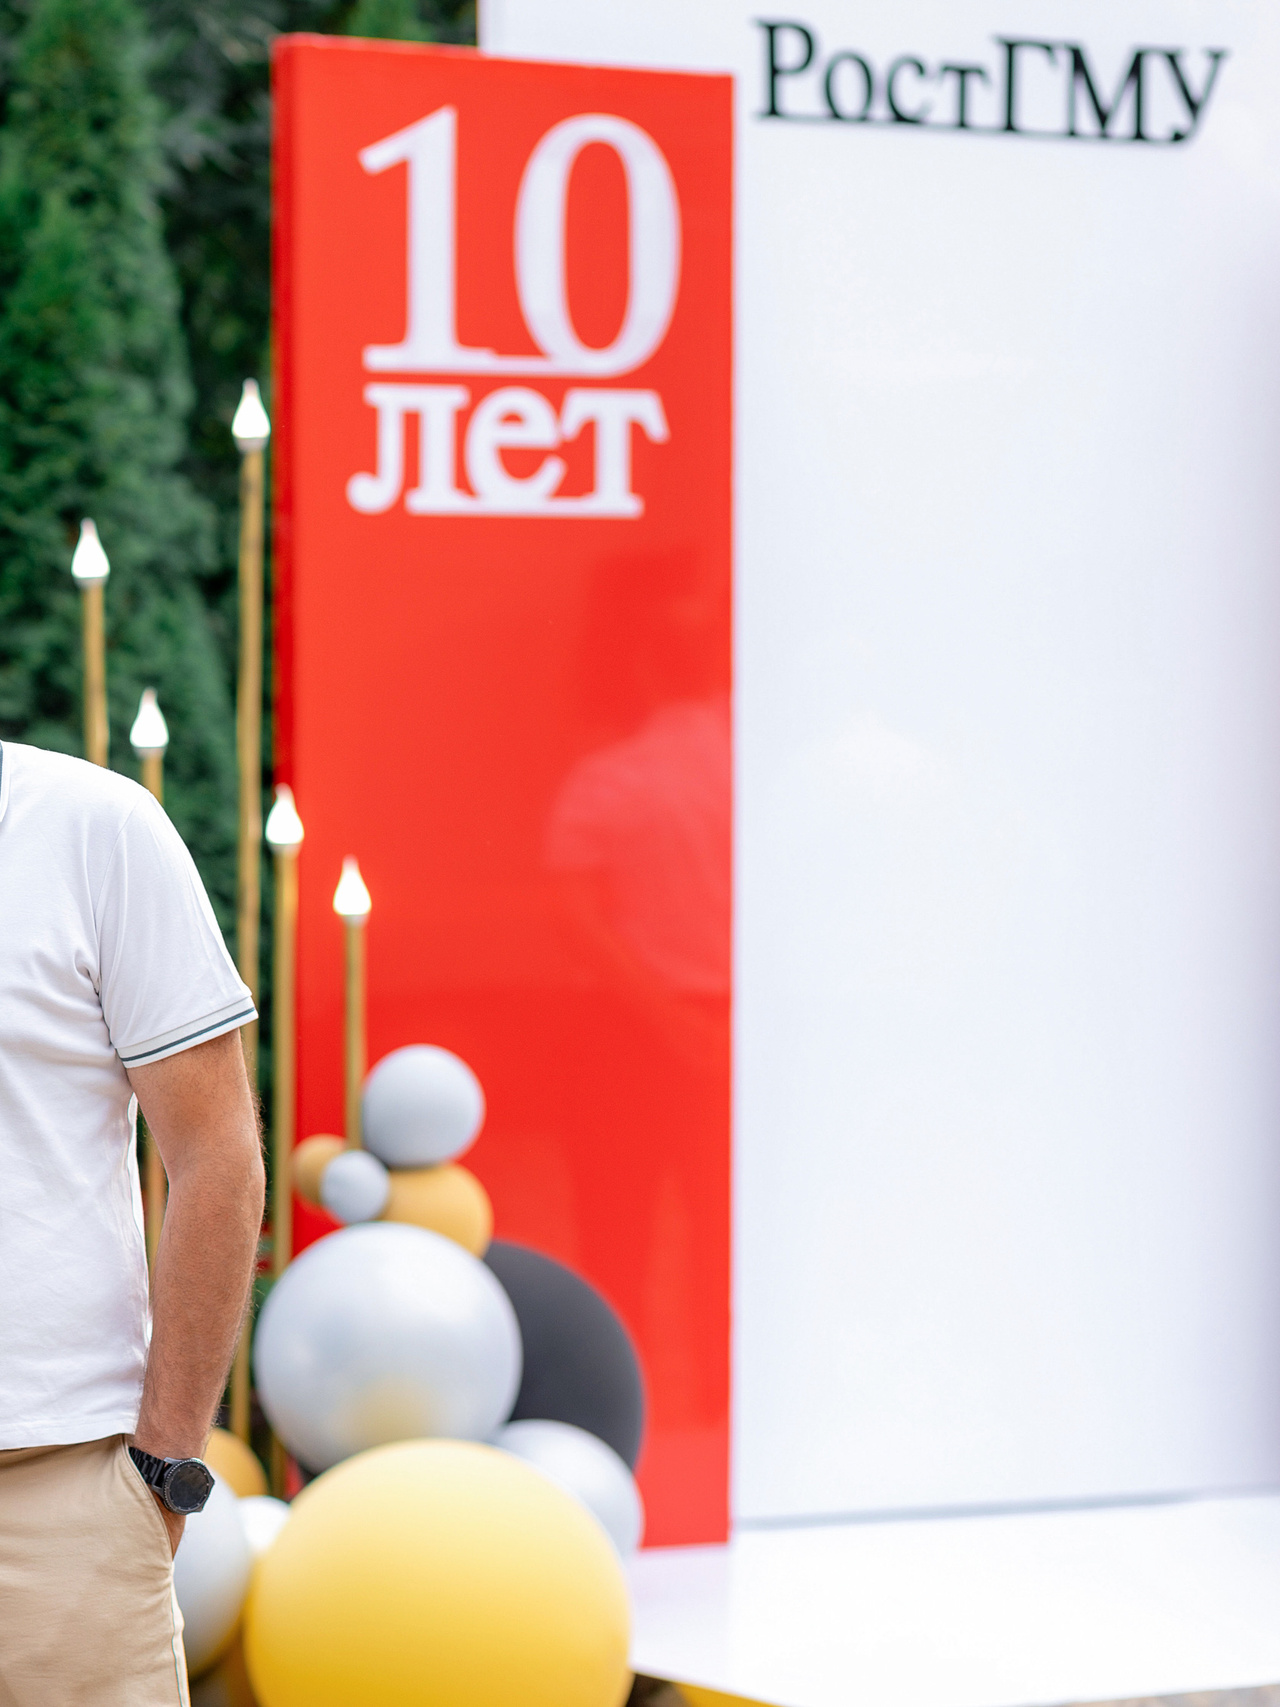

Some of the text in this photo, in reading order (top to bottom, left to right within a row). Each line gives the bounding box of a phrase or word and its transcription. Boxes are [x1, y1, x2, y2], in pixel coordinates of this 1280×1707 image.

[757, 19, 1227, 146] РостГМУ
[360, 107, 681, 376] 10
[347, 384, 668, 518] лет
